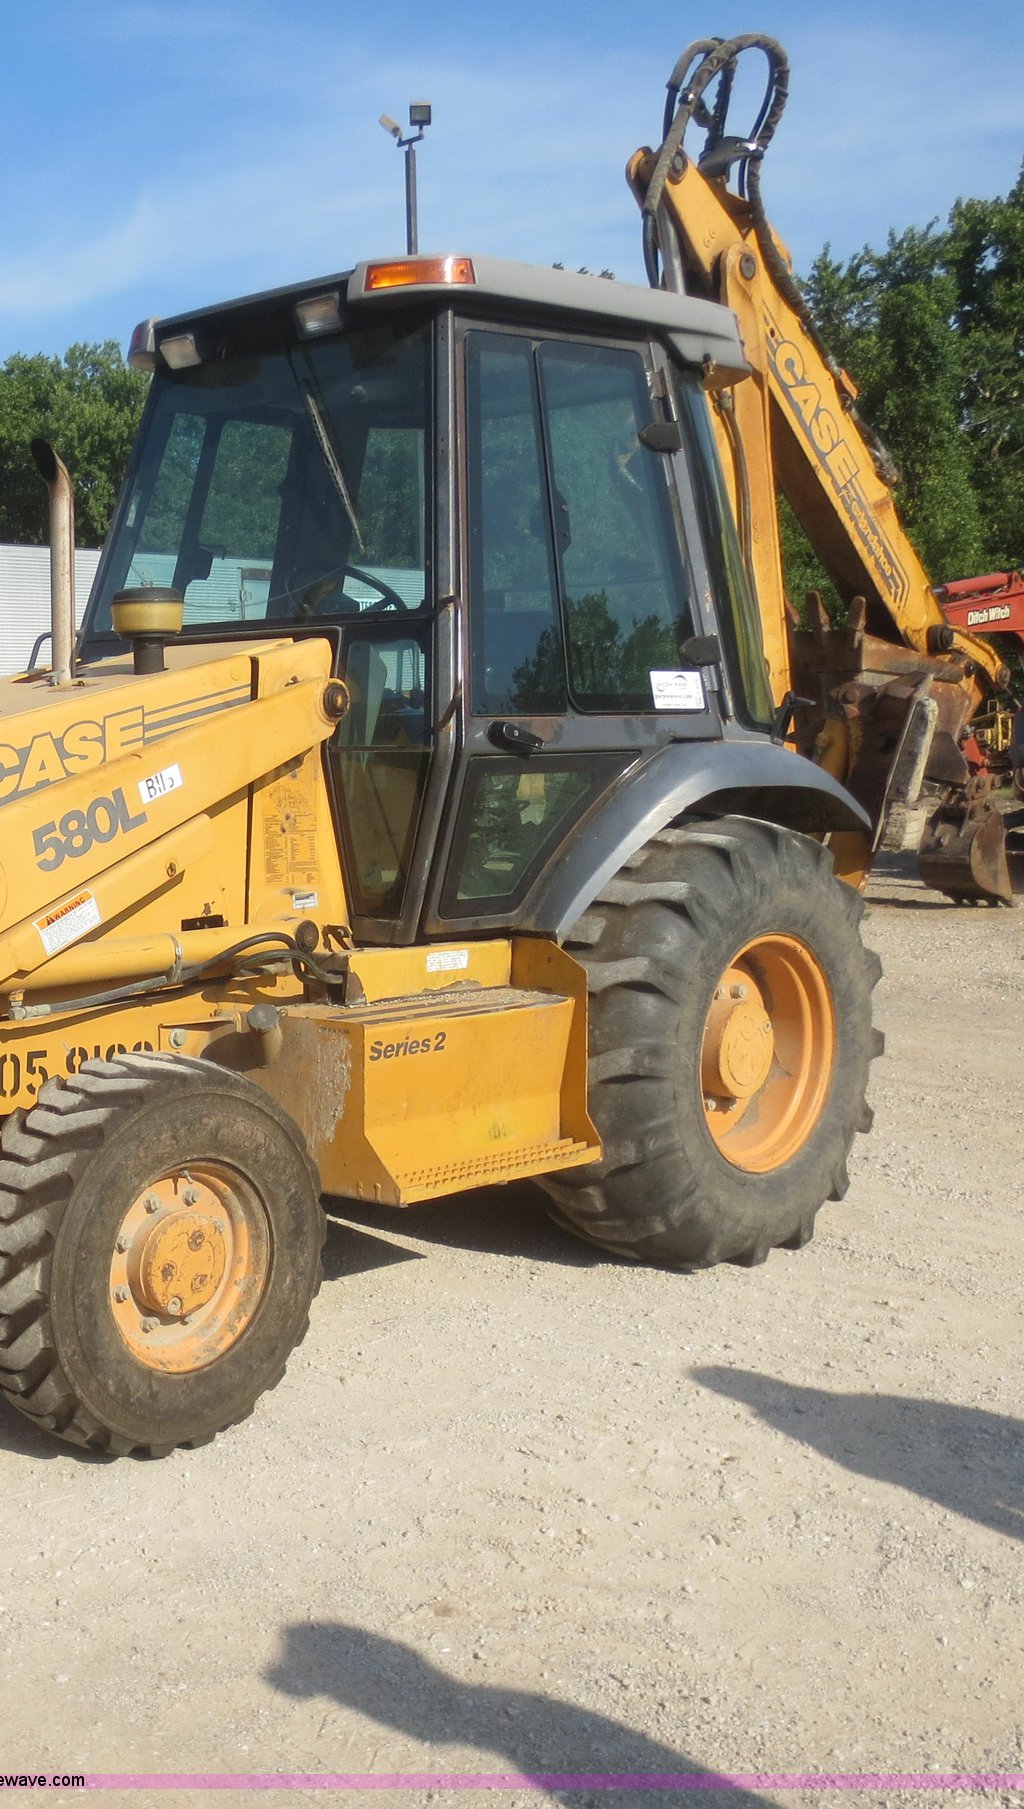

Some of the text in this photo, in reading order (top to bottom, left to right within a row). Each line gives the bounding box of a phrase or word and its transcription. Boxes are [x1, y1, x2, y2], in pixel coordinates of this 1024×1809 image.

[775, 339, 860, 489] CASE
[967, 604, 1010, 627] Ditch Witch
[32, 787, 148, 872] 580L
[53, 896, 86, 921] WARNING
[368, 1031, 447, 1061] Series 2
